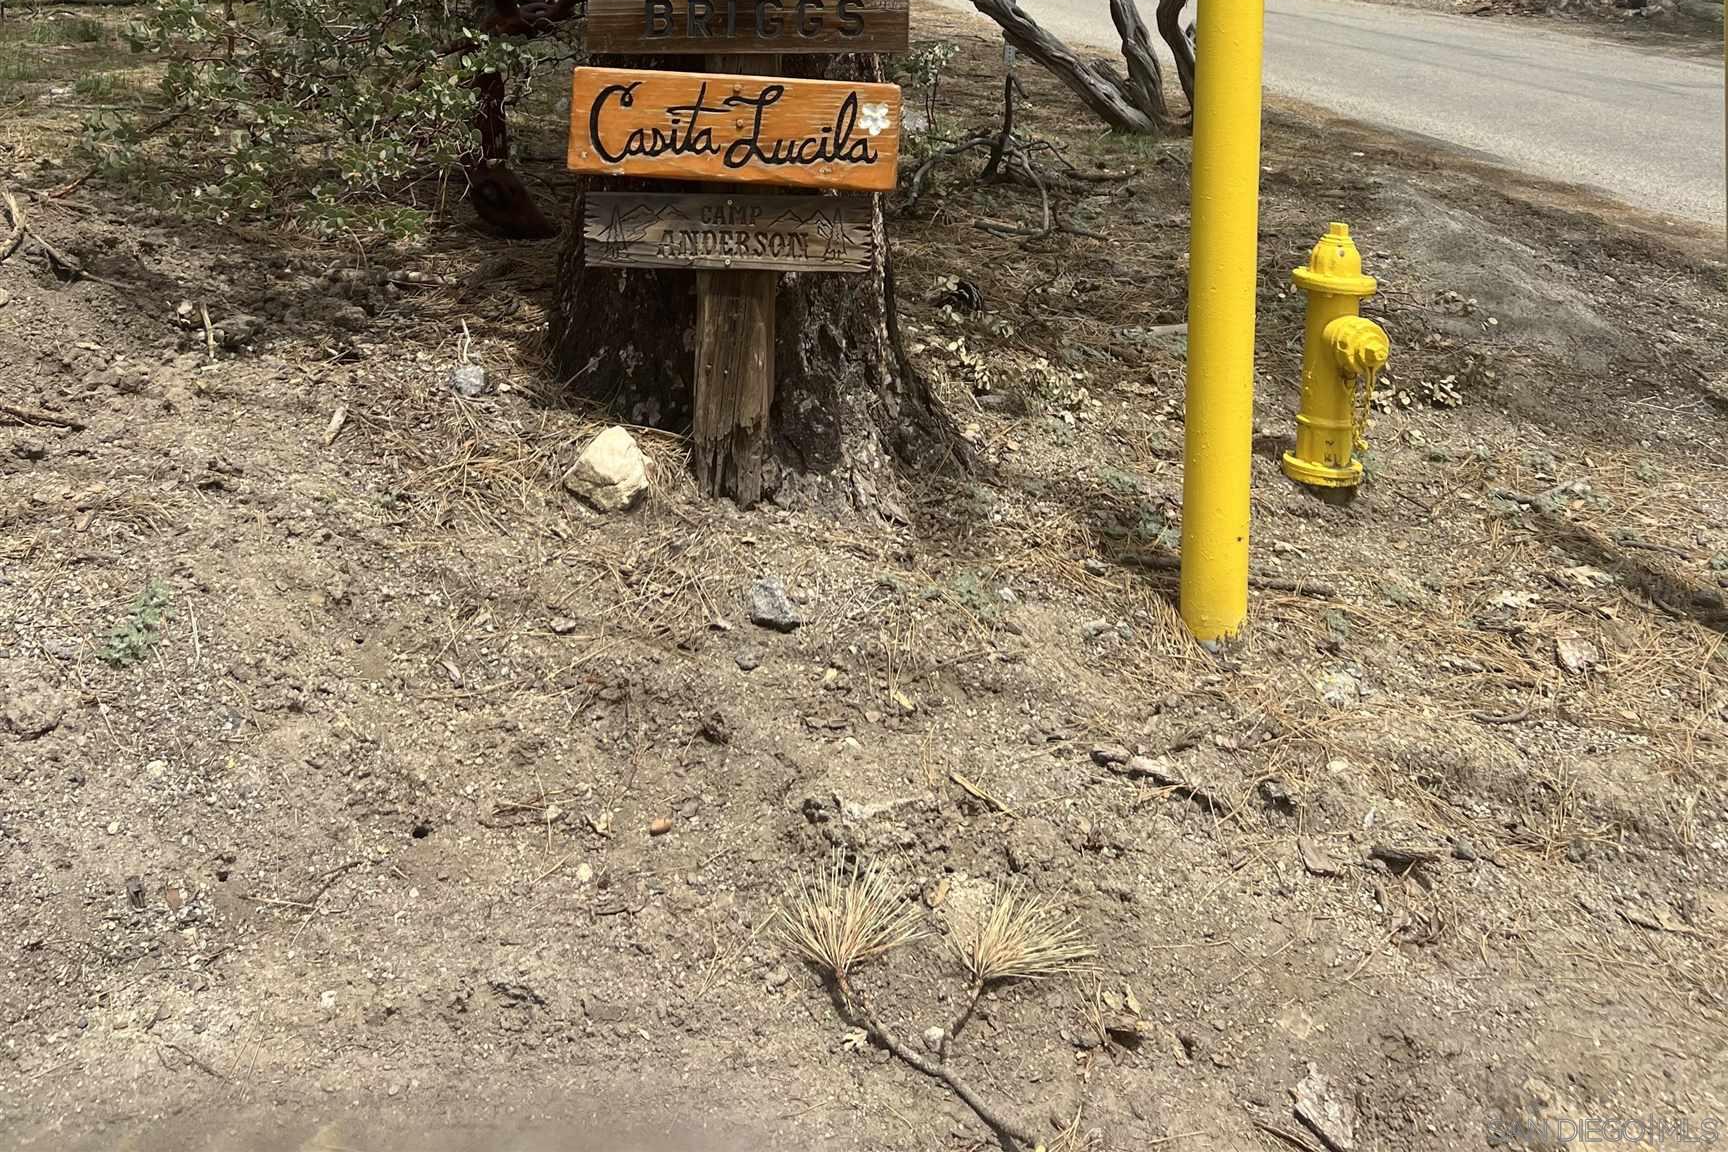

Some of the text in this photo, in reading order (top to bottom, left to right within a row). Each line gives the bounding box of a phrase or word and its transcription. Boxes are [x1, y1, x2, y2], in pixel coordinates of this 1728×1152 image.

[589, 81, 878, 169] Casita Lucila
[700, 205, 763, 227] CAMP
[656, 229, 812, 259] ANDERSON
